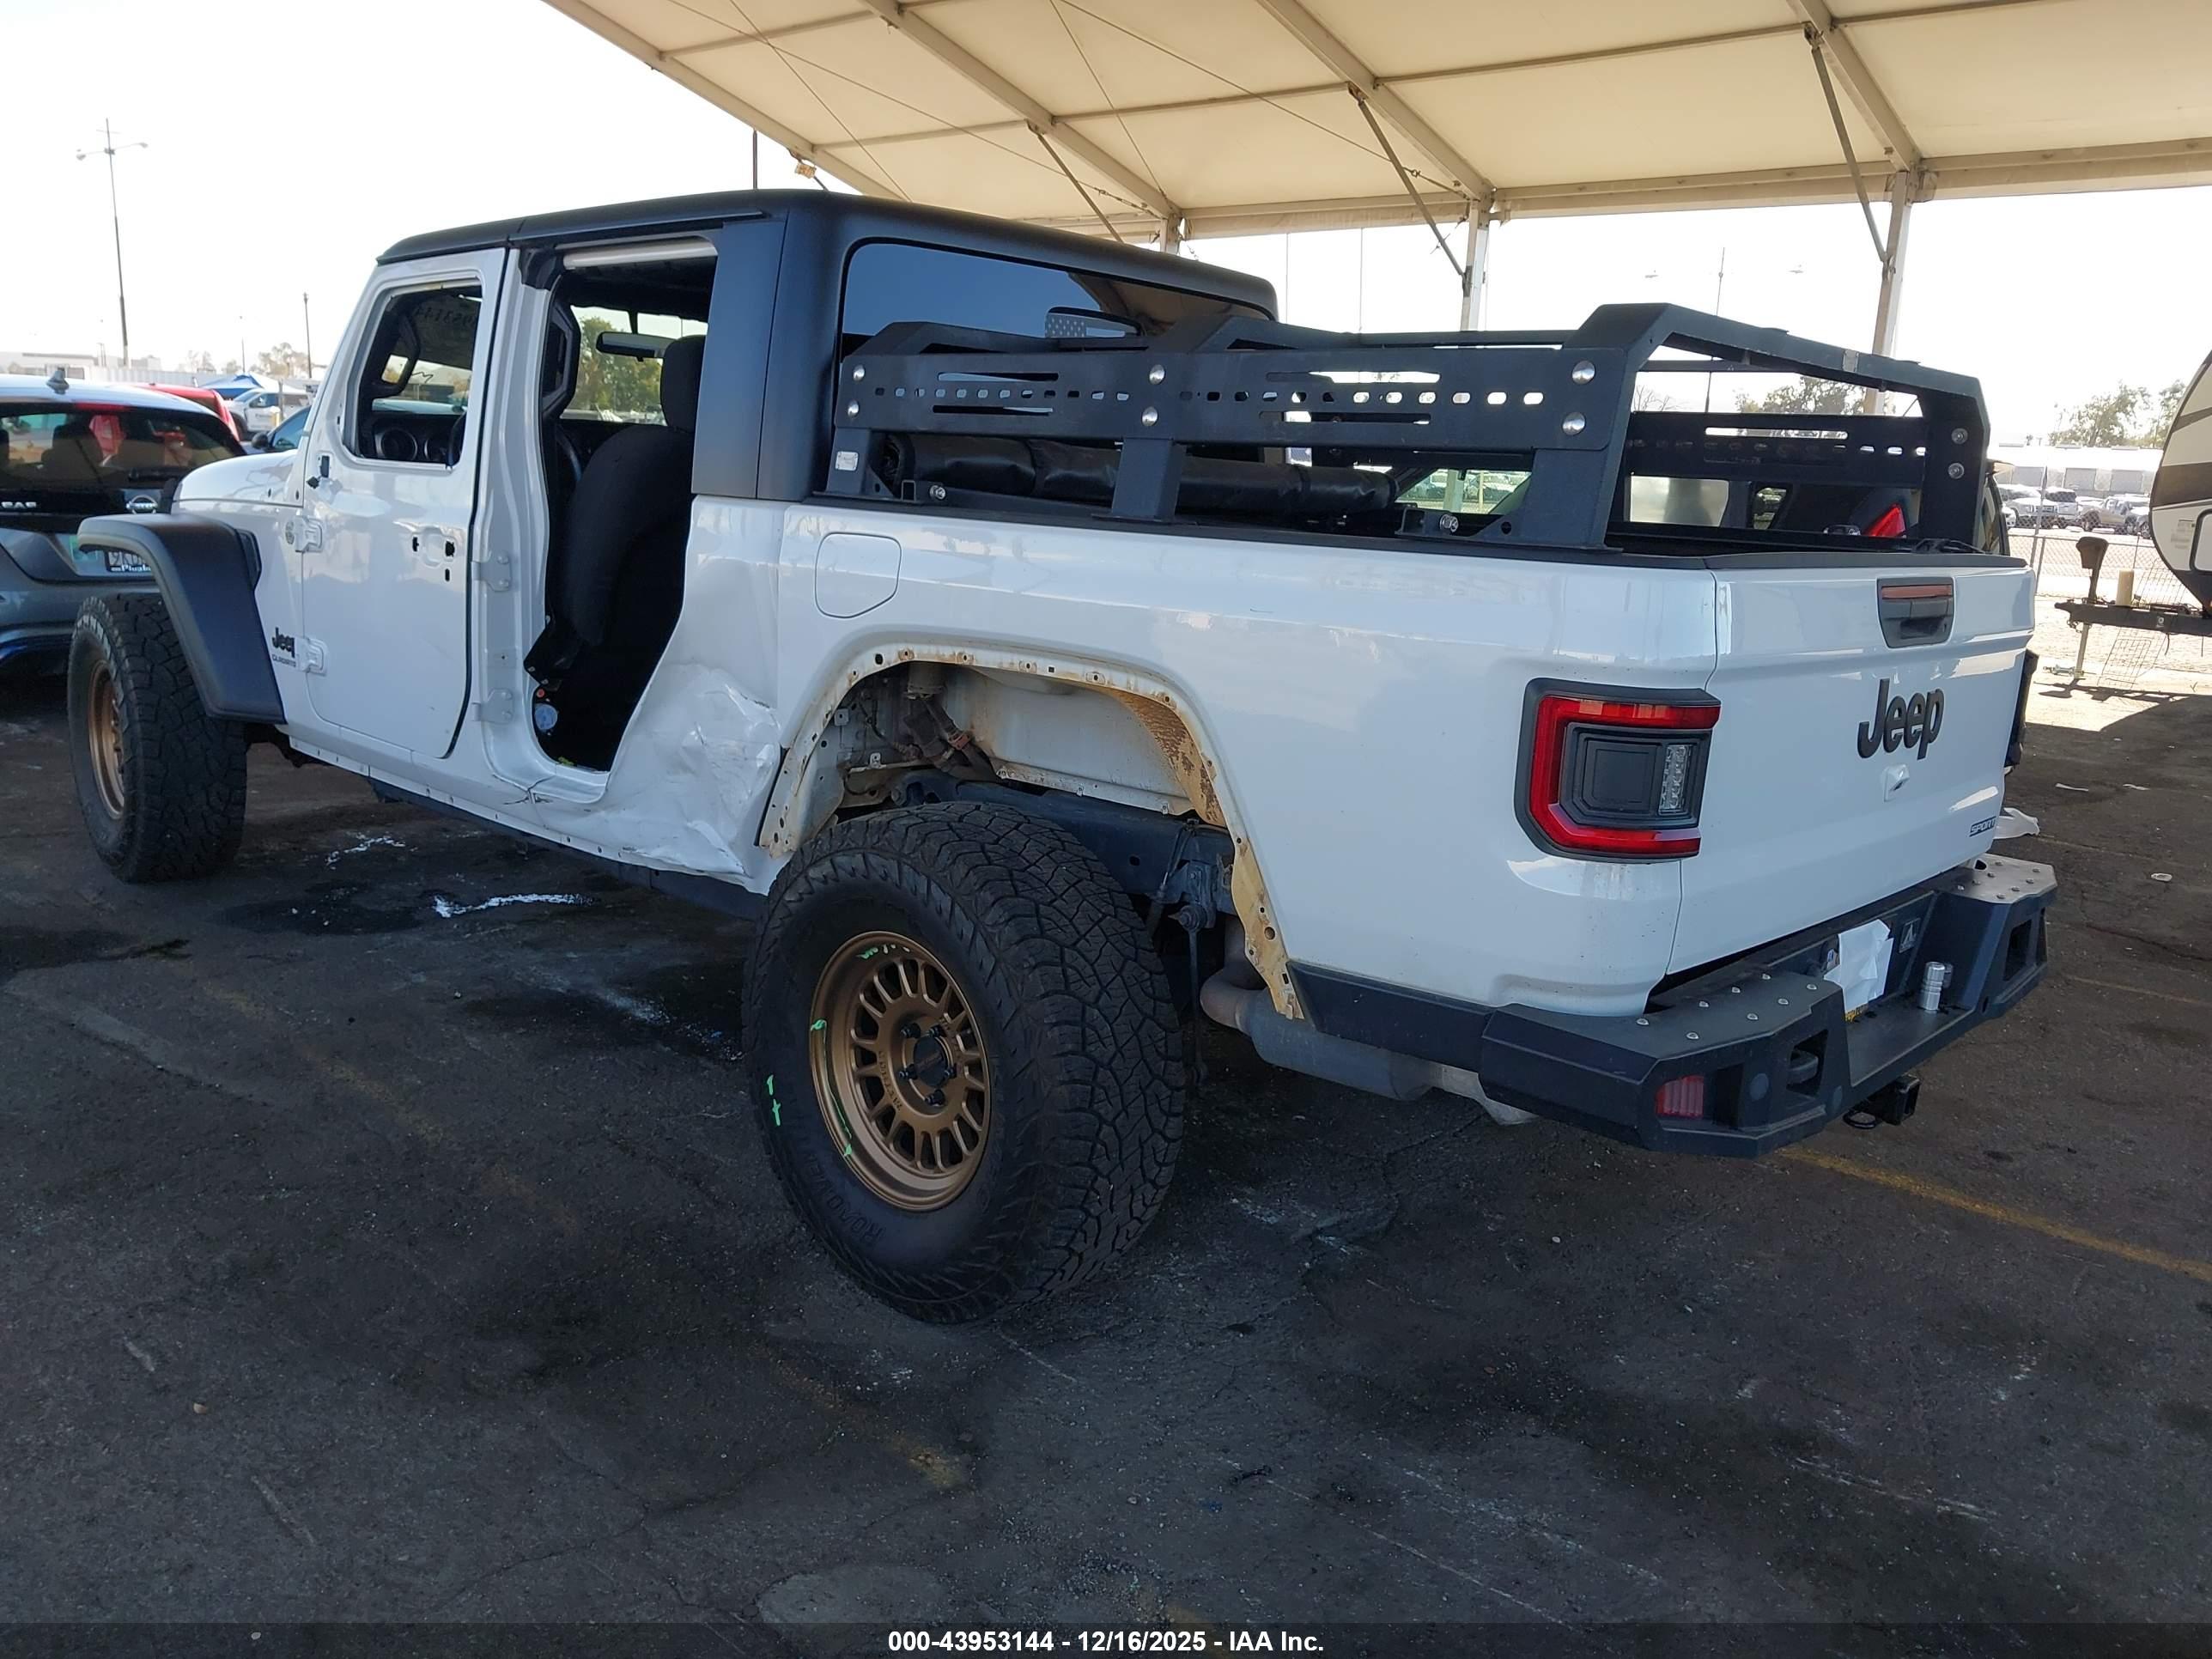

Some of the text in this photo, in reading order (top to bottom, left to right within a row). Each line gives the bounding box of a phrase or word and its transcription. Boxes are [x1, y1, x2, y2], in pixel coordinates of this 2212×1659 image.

[0, 501, 37, 509] EAF
[271, 626, 295, 659] Jeep
[1857, 678, 1945, 761] Jeep
[1970, 817, 1996, 836] SPORT
